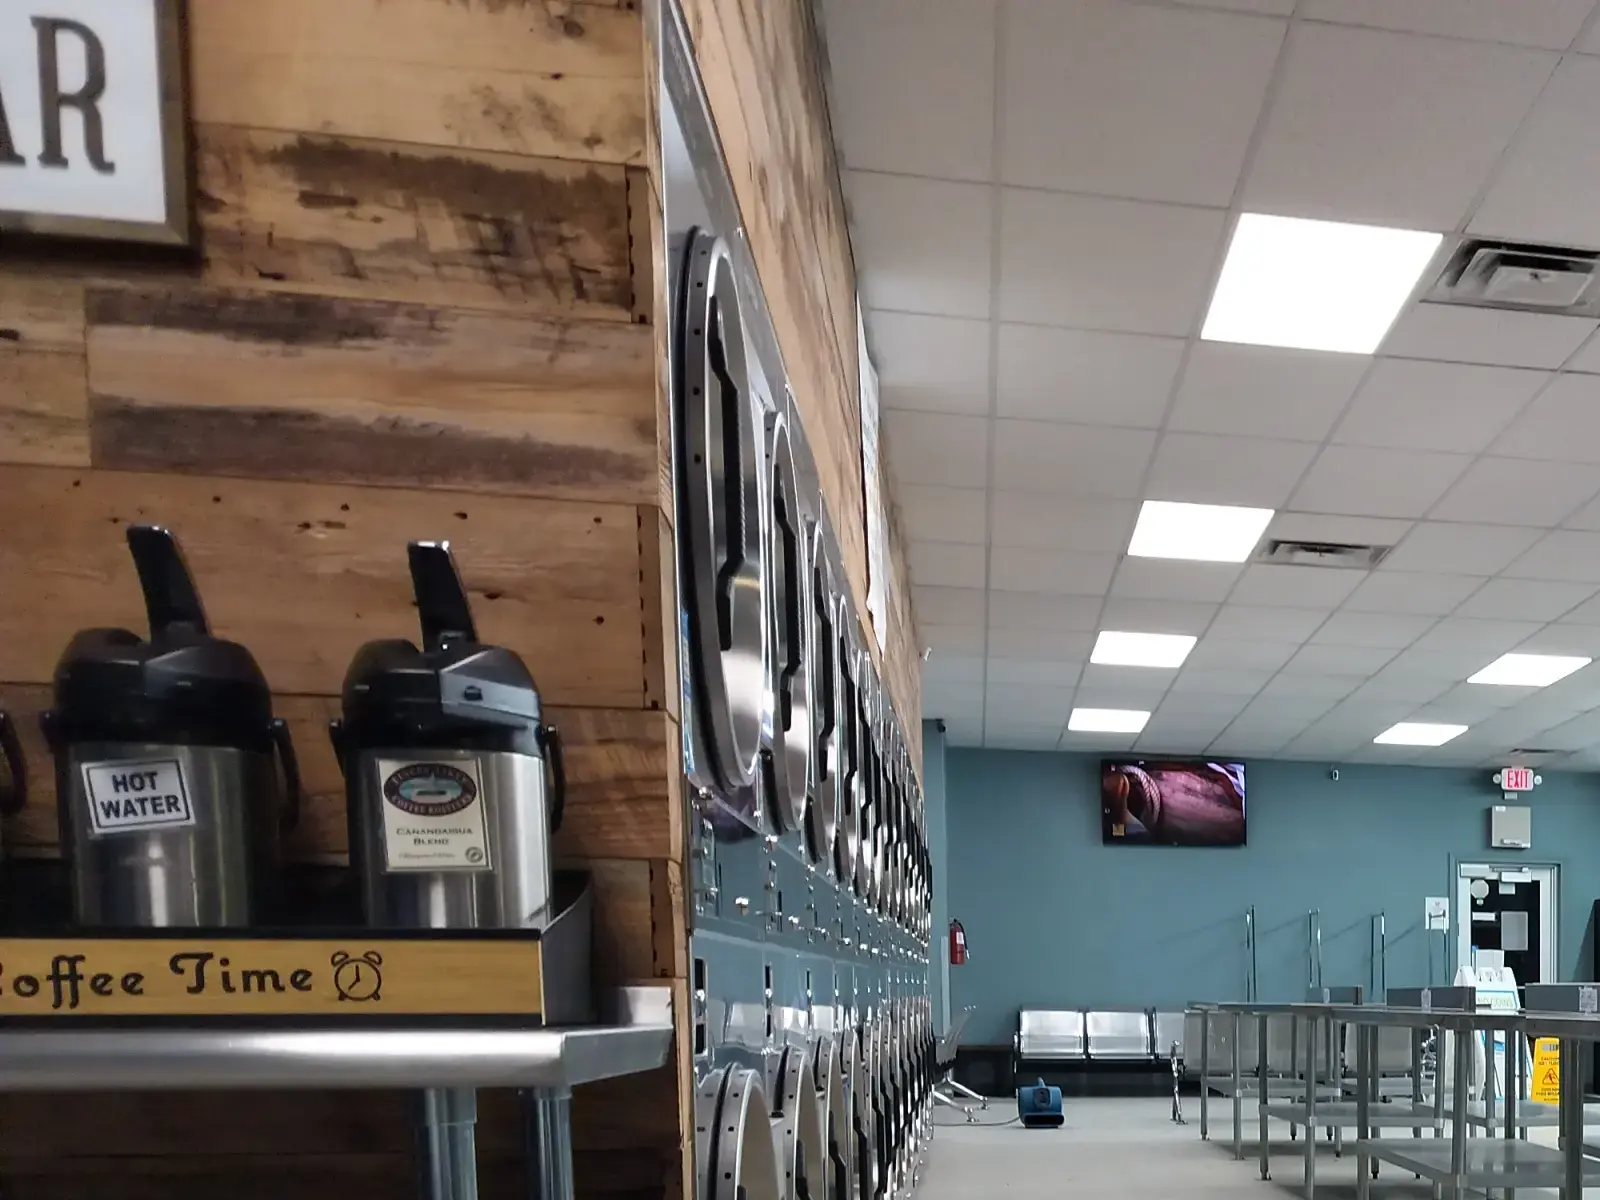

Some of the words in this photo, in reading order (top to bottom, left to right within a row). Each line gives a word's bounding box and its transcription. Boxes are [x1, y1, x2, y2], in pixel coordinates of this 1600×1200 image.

[111, 771, 158, 793] HOT
[1507, 769, 1530, 789] EXIT
[100, 795, 181, 819] WATER
[169, 951, 313, 995] Time
